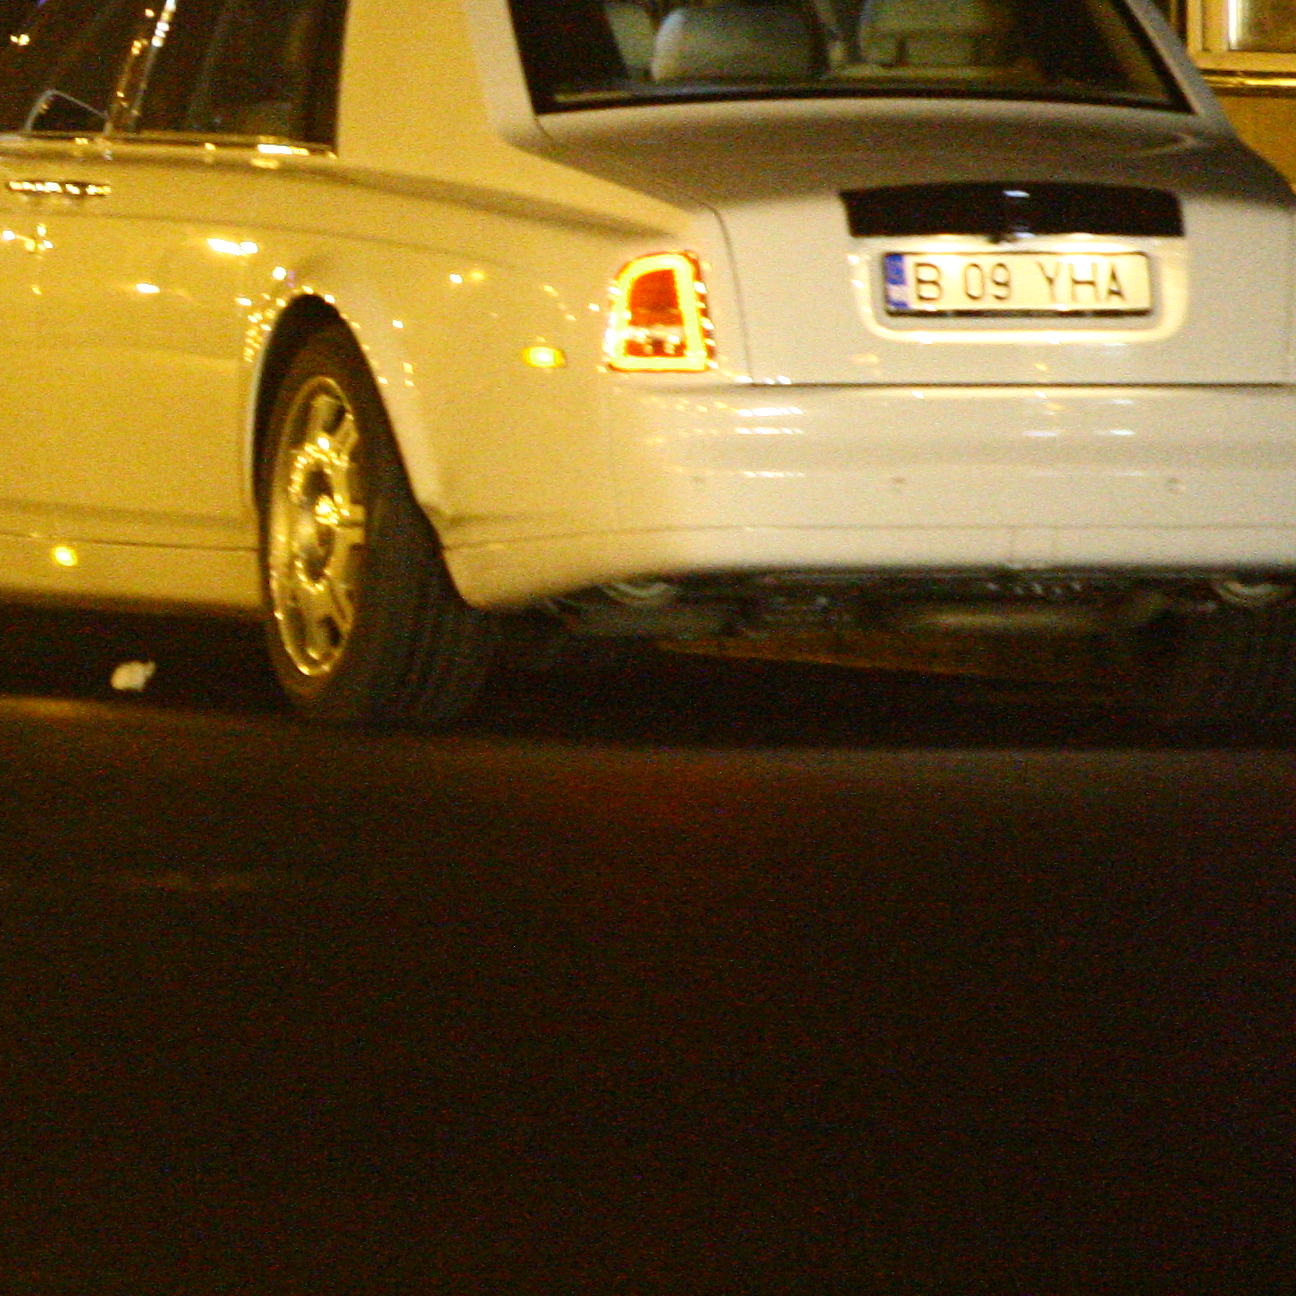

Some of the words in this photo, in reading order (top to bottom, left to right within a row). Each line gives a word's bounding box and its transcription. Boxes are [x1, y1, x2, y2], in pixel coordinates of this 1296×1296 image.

[915, 262, 943, 301] B
[964, 262, 1011, 301] 09
[1038, 261, 1126, 303] YHA
